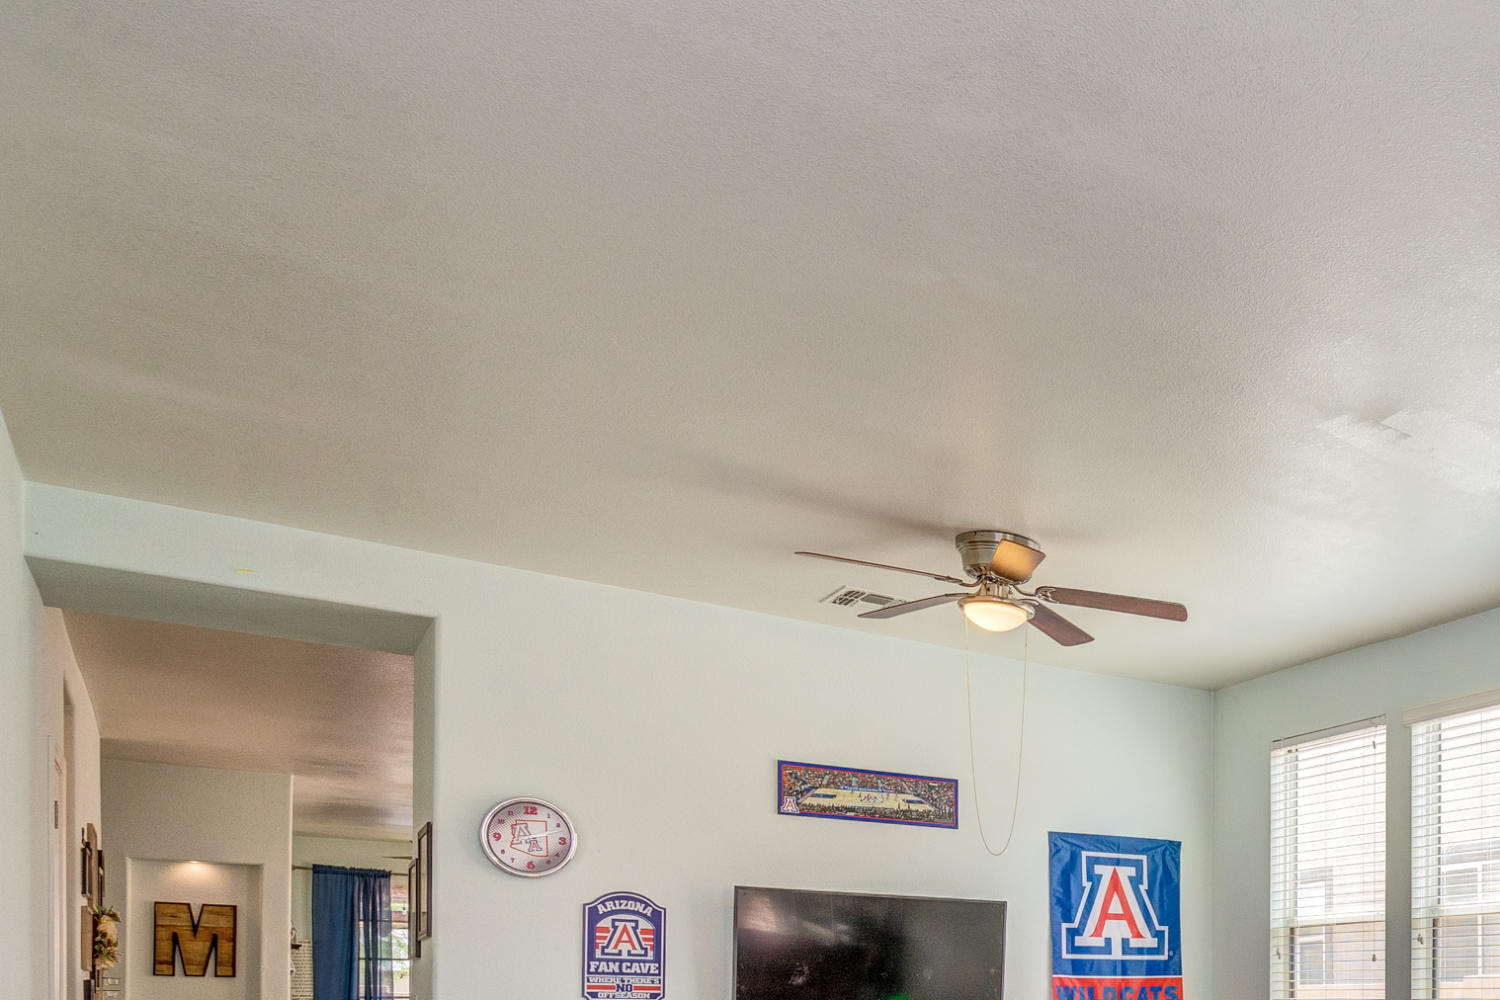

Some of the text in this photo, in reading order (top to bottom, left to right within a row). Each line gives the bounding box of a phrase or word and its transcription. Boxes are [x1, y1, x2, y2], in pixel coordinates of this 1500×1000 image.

[523, 806, 538, 815] 12
[493, 832, 502, 841] 9
[559, 837, 567, 845] 3
[527, 861, 535, 869] 6
[597, 900, 654, 917] ARIZONA
[1061, 851, 1169, 960] A
[153, 901, 238, 977] M
[601, 919, 648, 958] A
[589, 961, 659, 974] FAN CAVE
[616, 984, 633, 992] NO
